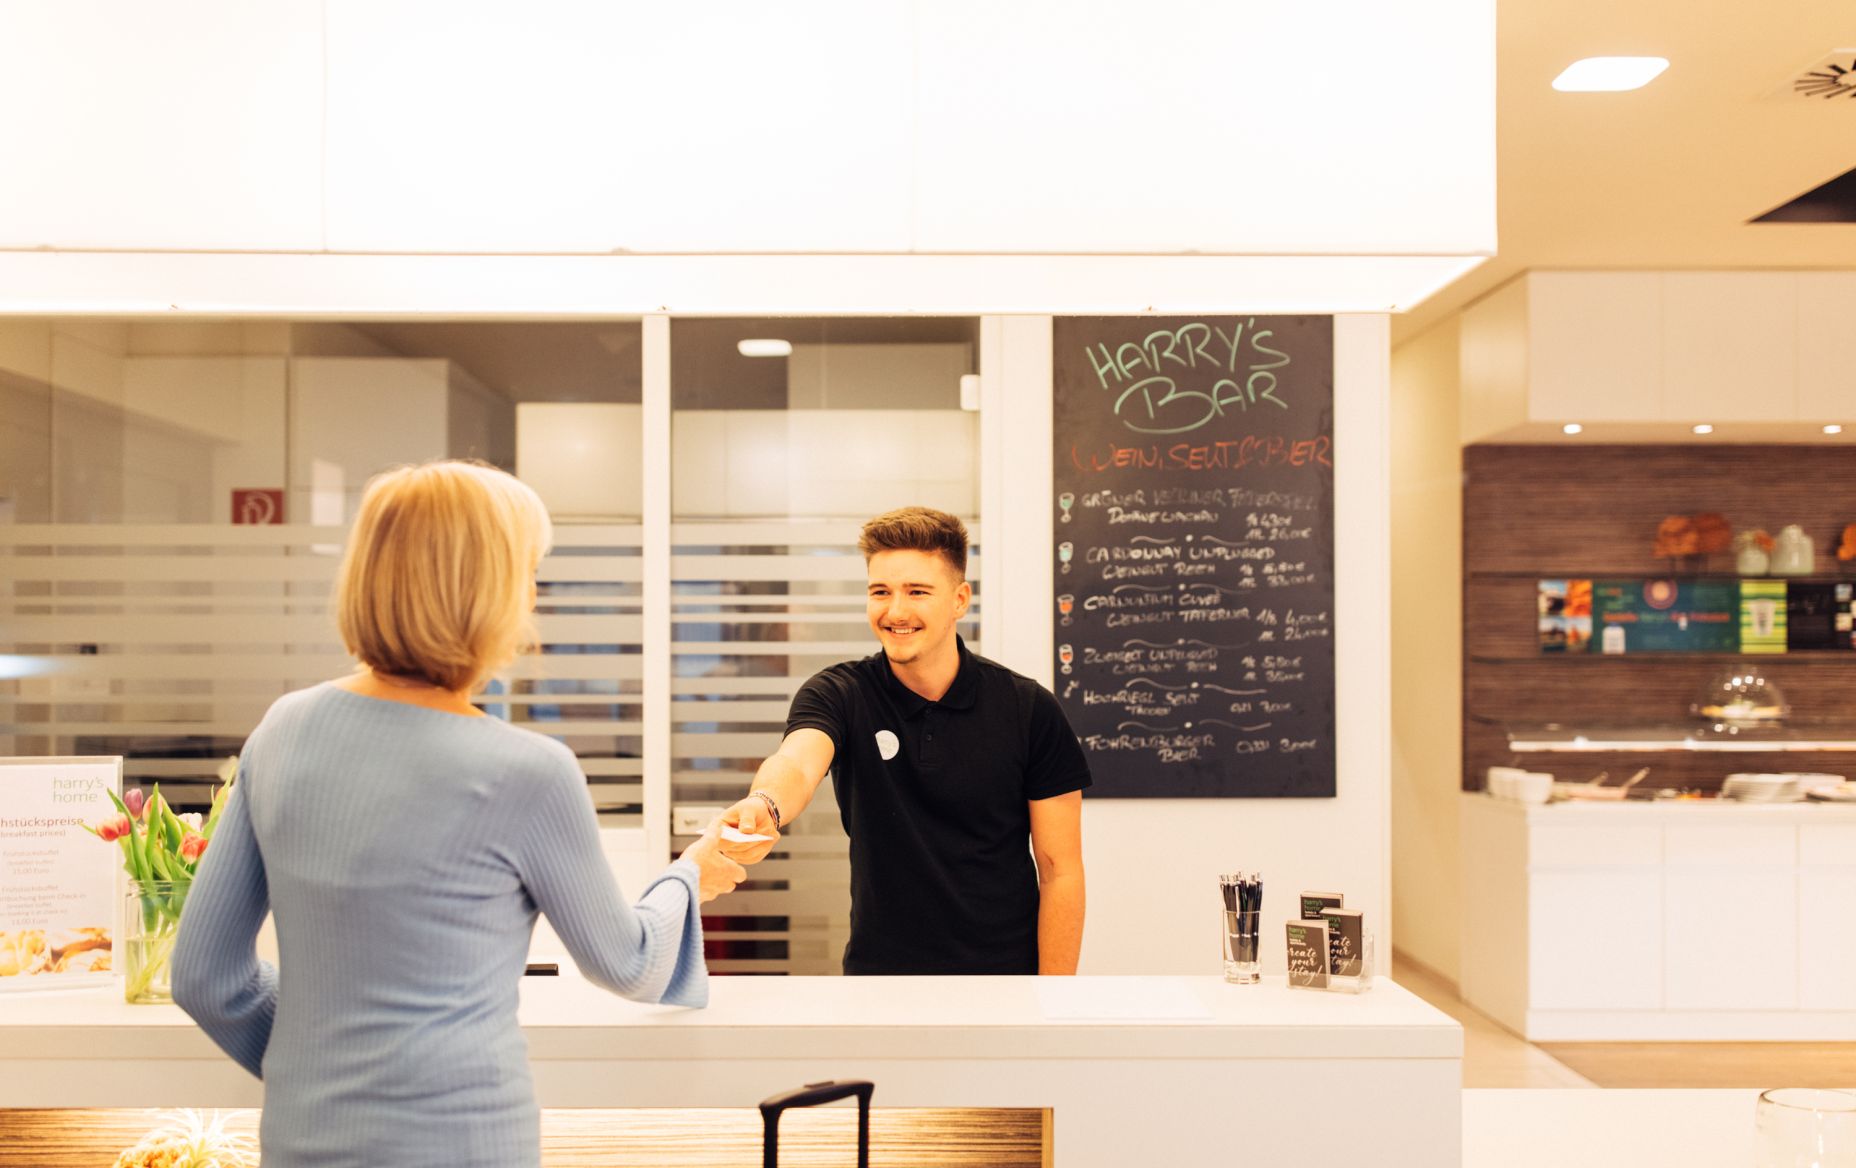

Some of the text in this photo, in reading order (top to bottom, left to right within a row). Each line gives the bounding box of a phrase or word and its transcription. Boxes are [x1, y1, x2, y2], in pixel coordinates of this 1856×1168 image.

[1086, 317, 1291, 389] HARRY'S
[1113, 371, 1289, 434] BAR
[53, 775, 105, 792] harry's
[53, 790, 99, 804] home
[1287, 947, 1318, 958] reate
